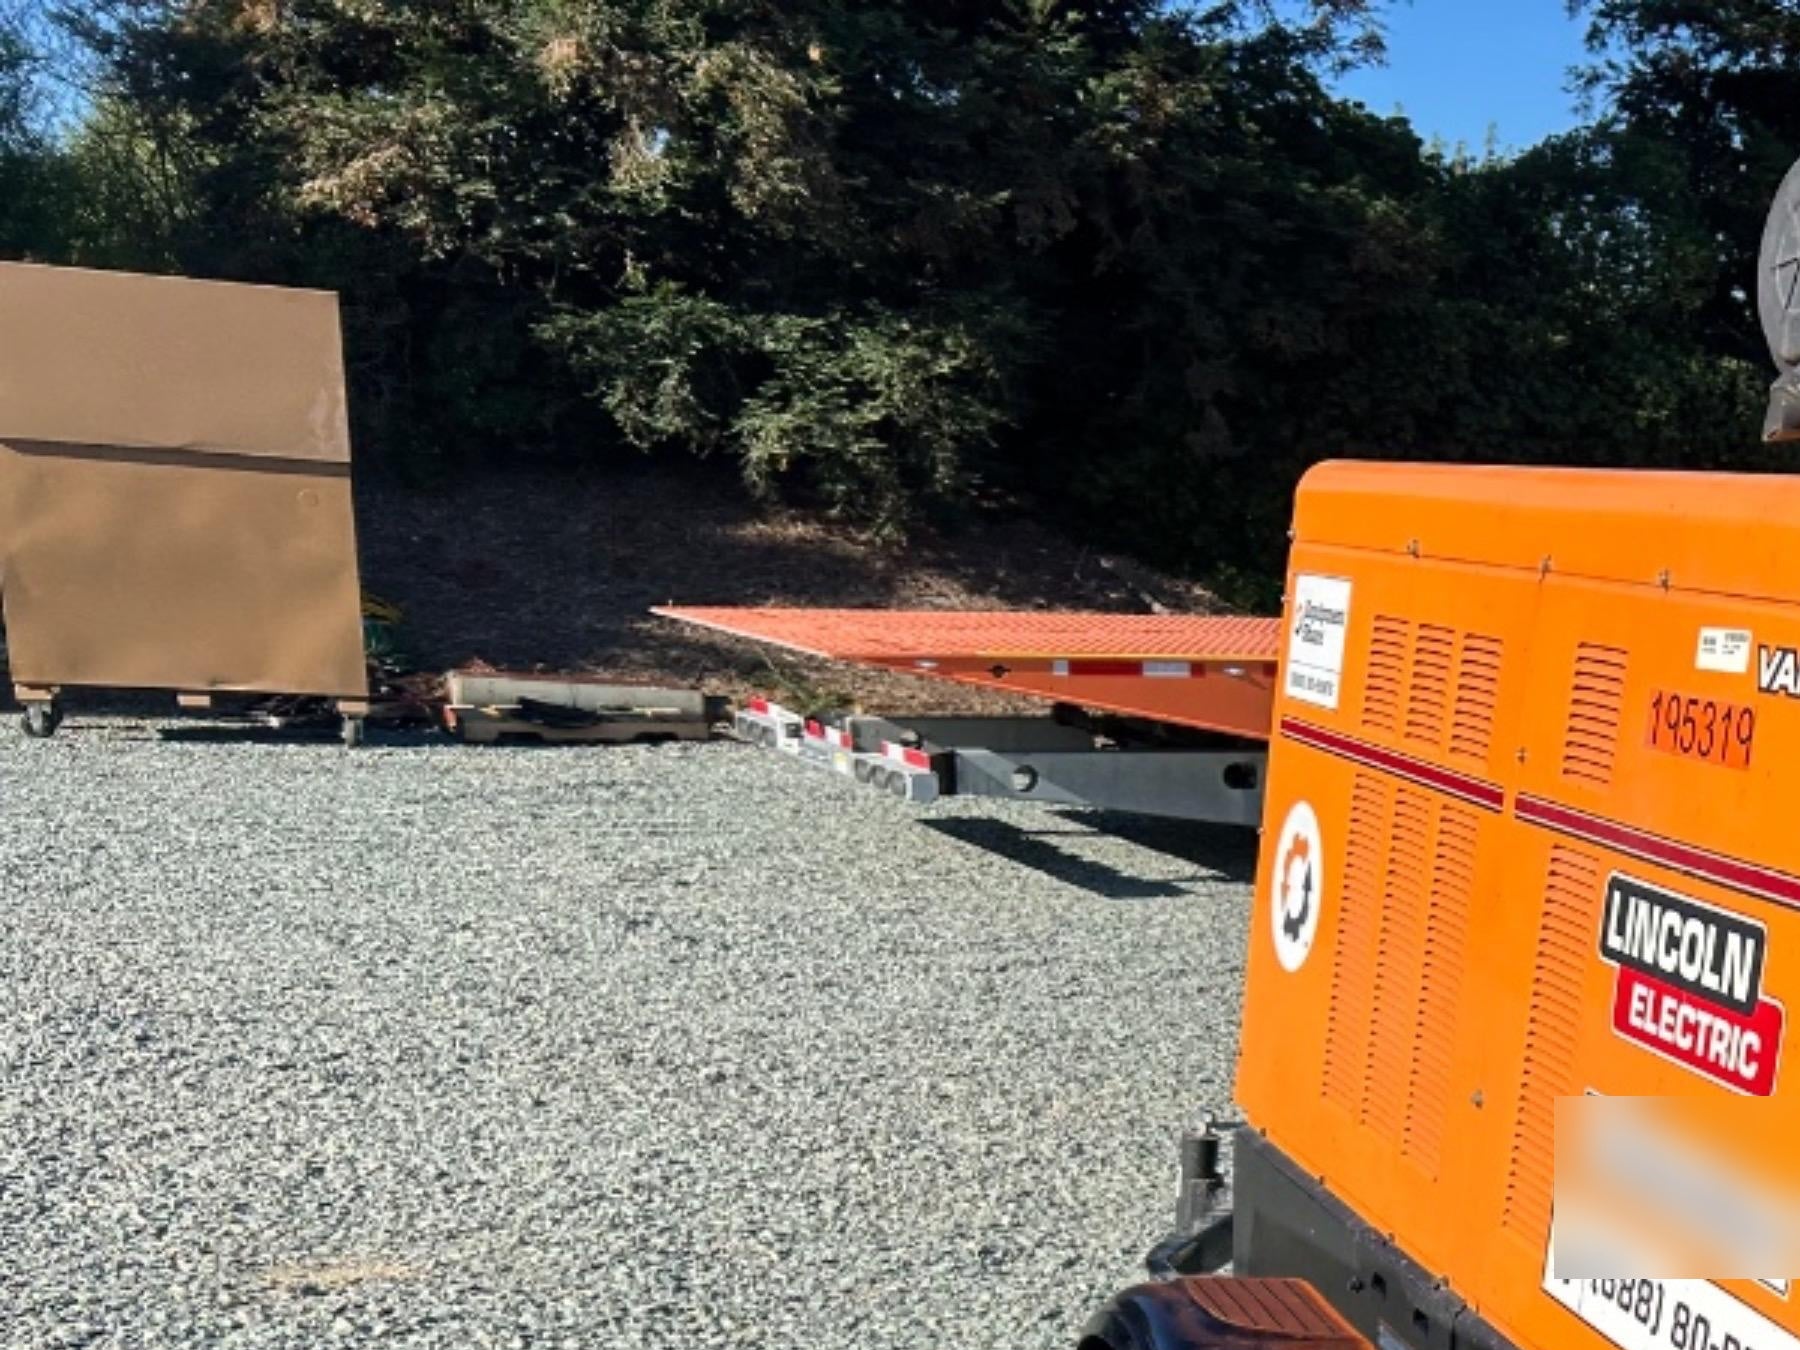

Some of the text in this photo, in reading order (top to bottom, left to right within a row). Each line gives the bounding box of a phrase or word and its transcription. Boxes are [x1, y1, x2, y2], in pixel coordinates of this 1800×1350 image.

[1651, 690, 1753, 766] 195319
[1607, 889, 1756, 1003] LINCOLN
[1627, 982, 1762, 1080] ELECTRIC
